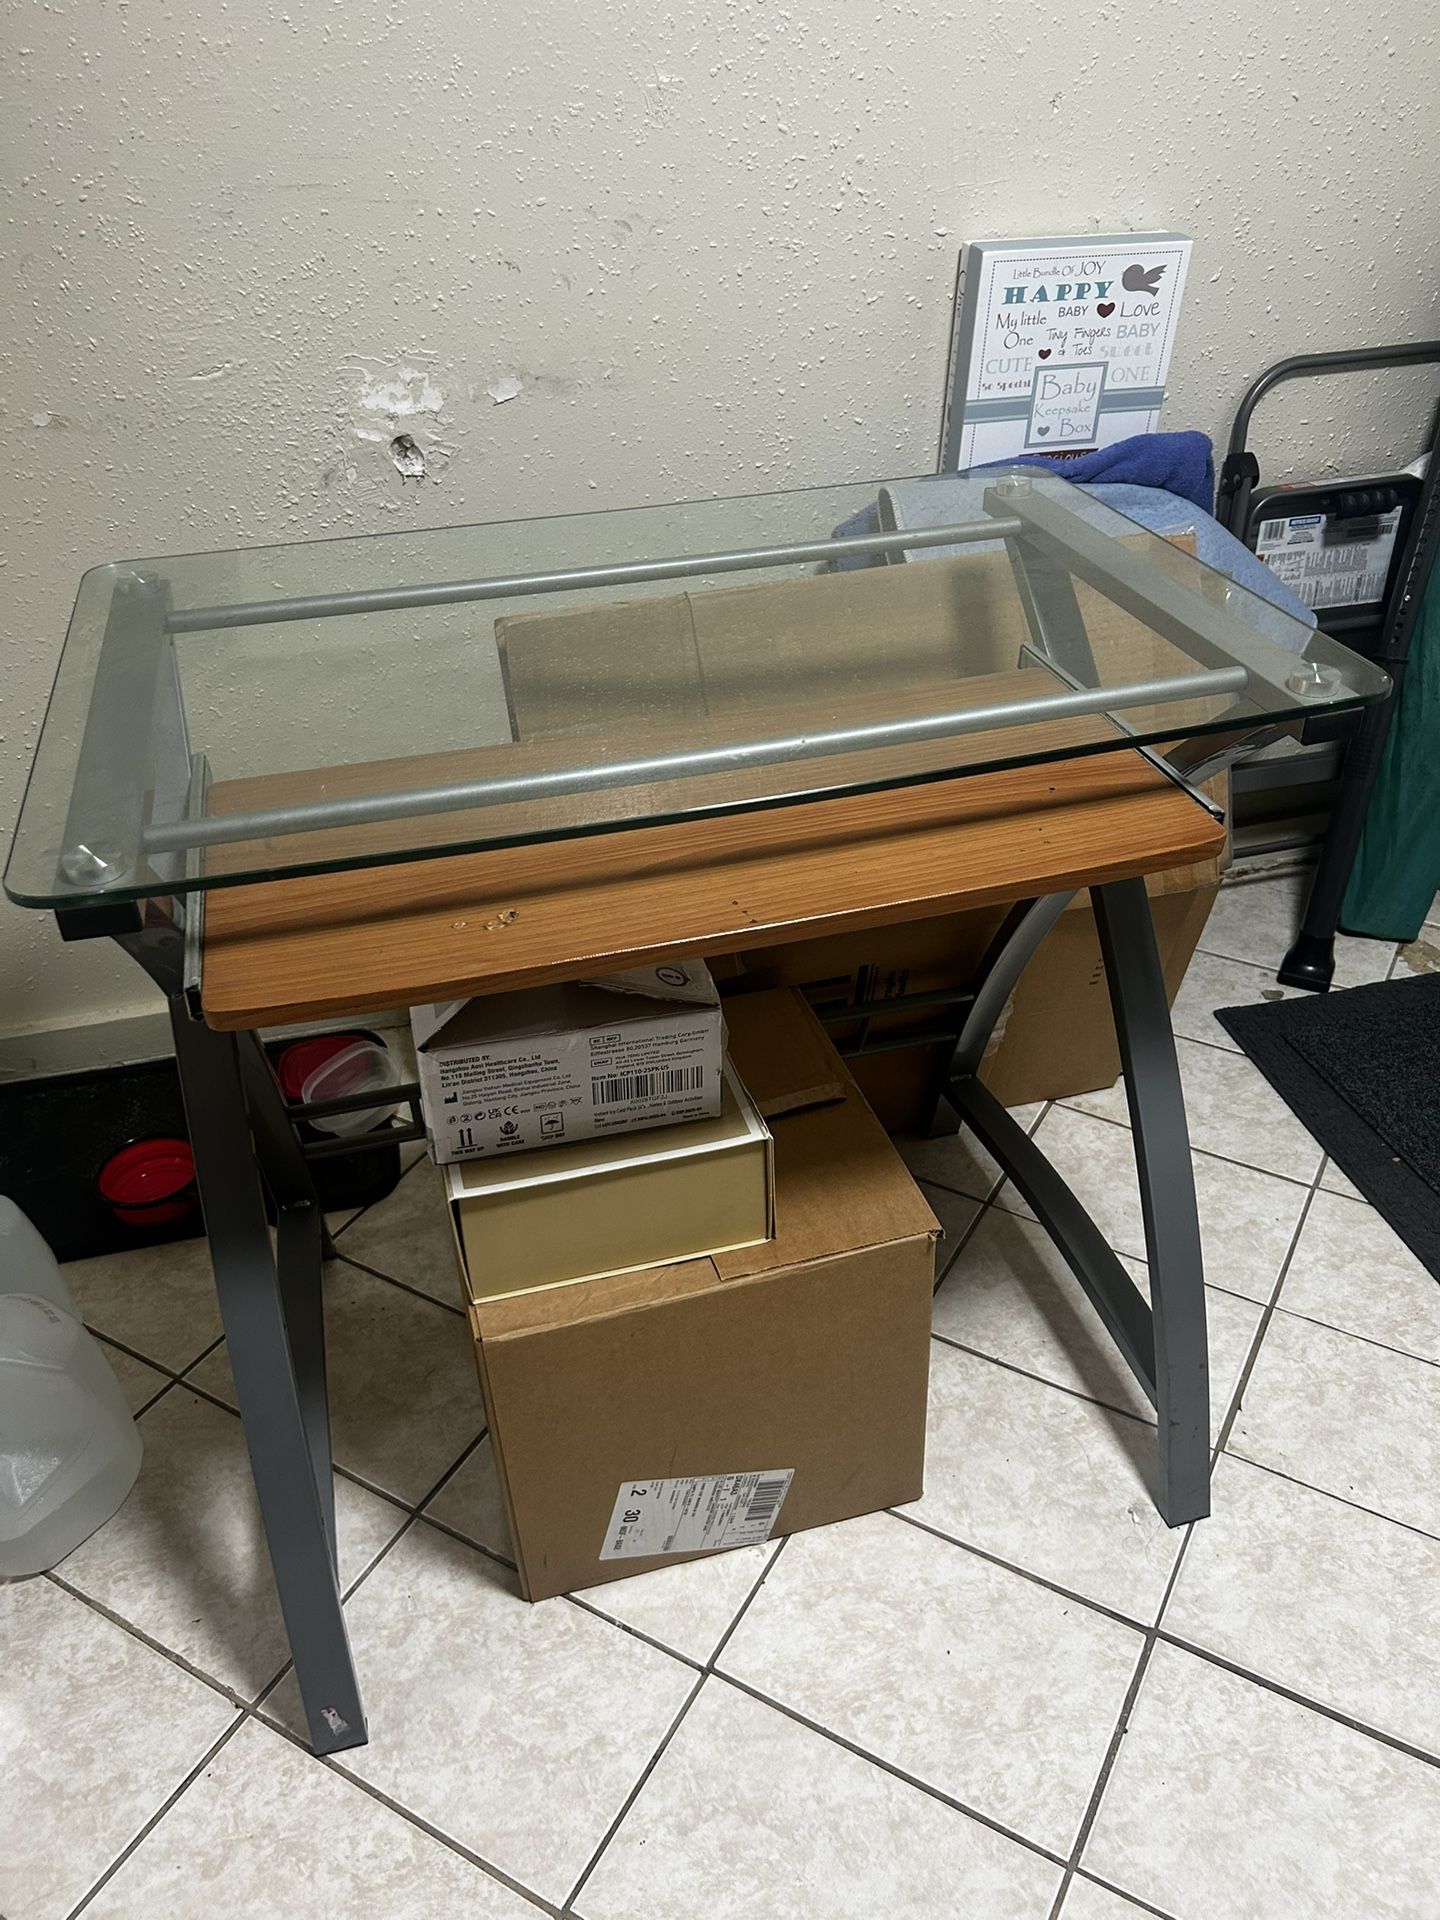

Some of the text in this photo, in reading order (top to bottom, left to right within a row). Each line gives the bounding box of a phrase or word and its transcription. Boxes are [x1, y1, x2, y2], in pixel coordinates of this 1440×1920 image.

[1013, 261, 1106, 280] Little Bundle Of JOY
[1002, 281, 1114, 305] HAPPY
[1057, 301, 1161, 318] BABY Love
[996, 310, 1047, 333] My little
[1046, 326, 1112, 348] Tiny Fingers
[1116, 322, 1161, 339] BABY
[1003, 331, 1034, 350] One
[1072, 343, 1093, 356] Toes
[985, 356, 1033, 374] CUTE
[1111, 366, 1150, 383] ONE
[1040, 371, 1097, 401] Baby
[1033, 403, 1091, 418] Keepsake
[1060, 417, 1092, 437] Box
[618, 1037, 654, 1046] International
[439, 1057, 480, 1067] DISTRIBUTED
[486, 1058, 516, 1067] Healthcare
[504, 1106, 518, 1115] CE
[451, 1148, 463, 1156] THIS
[623, 1509, 640, 1522] 30
